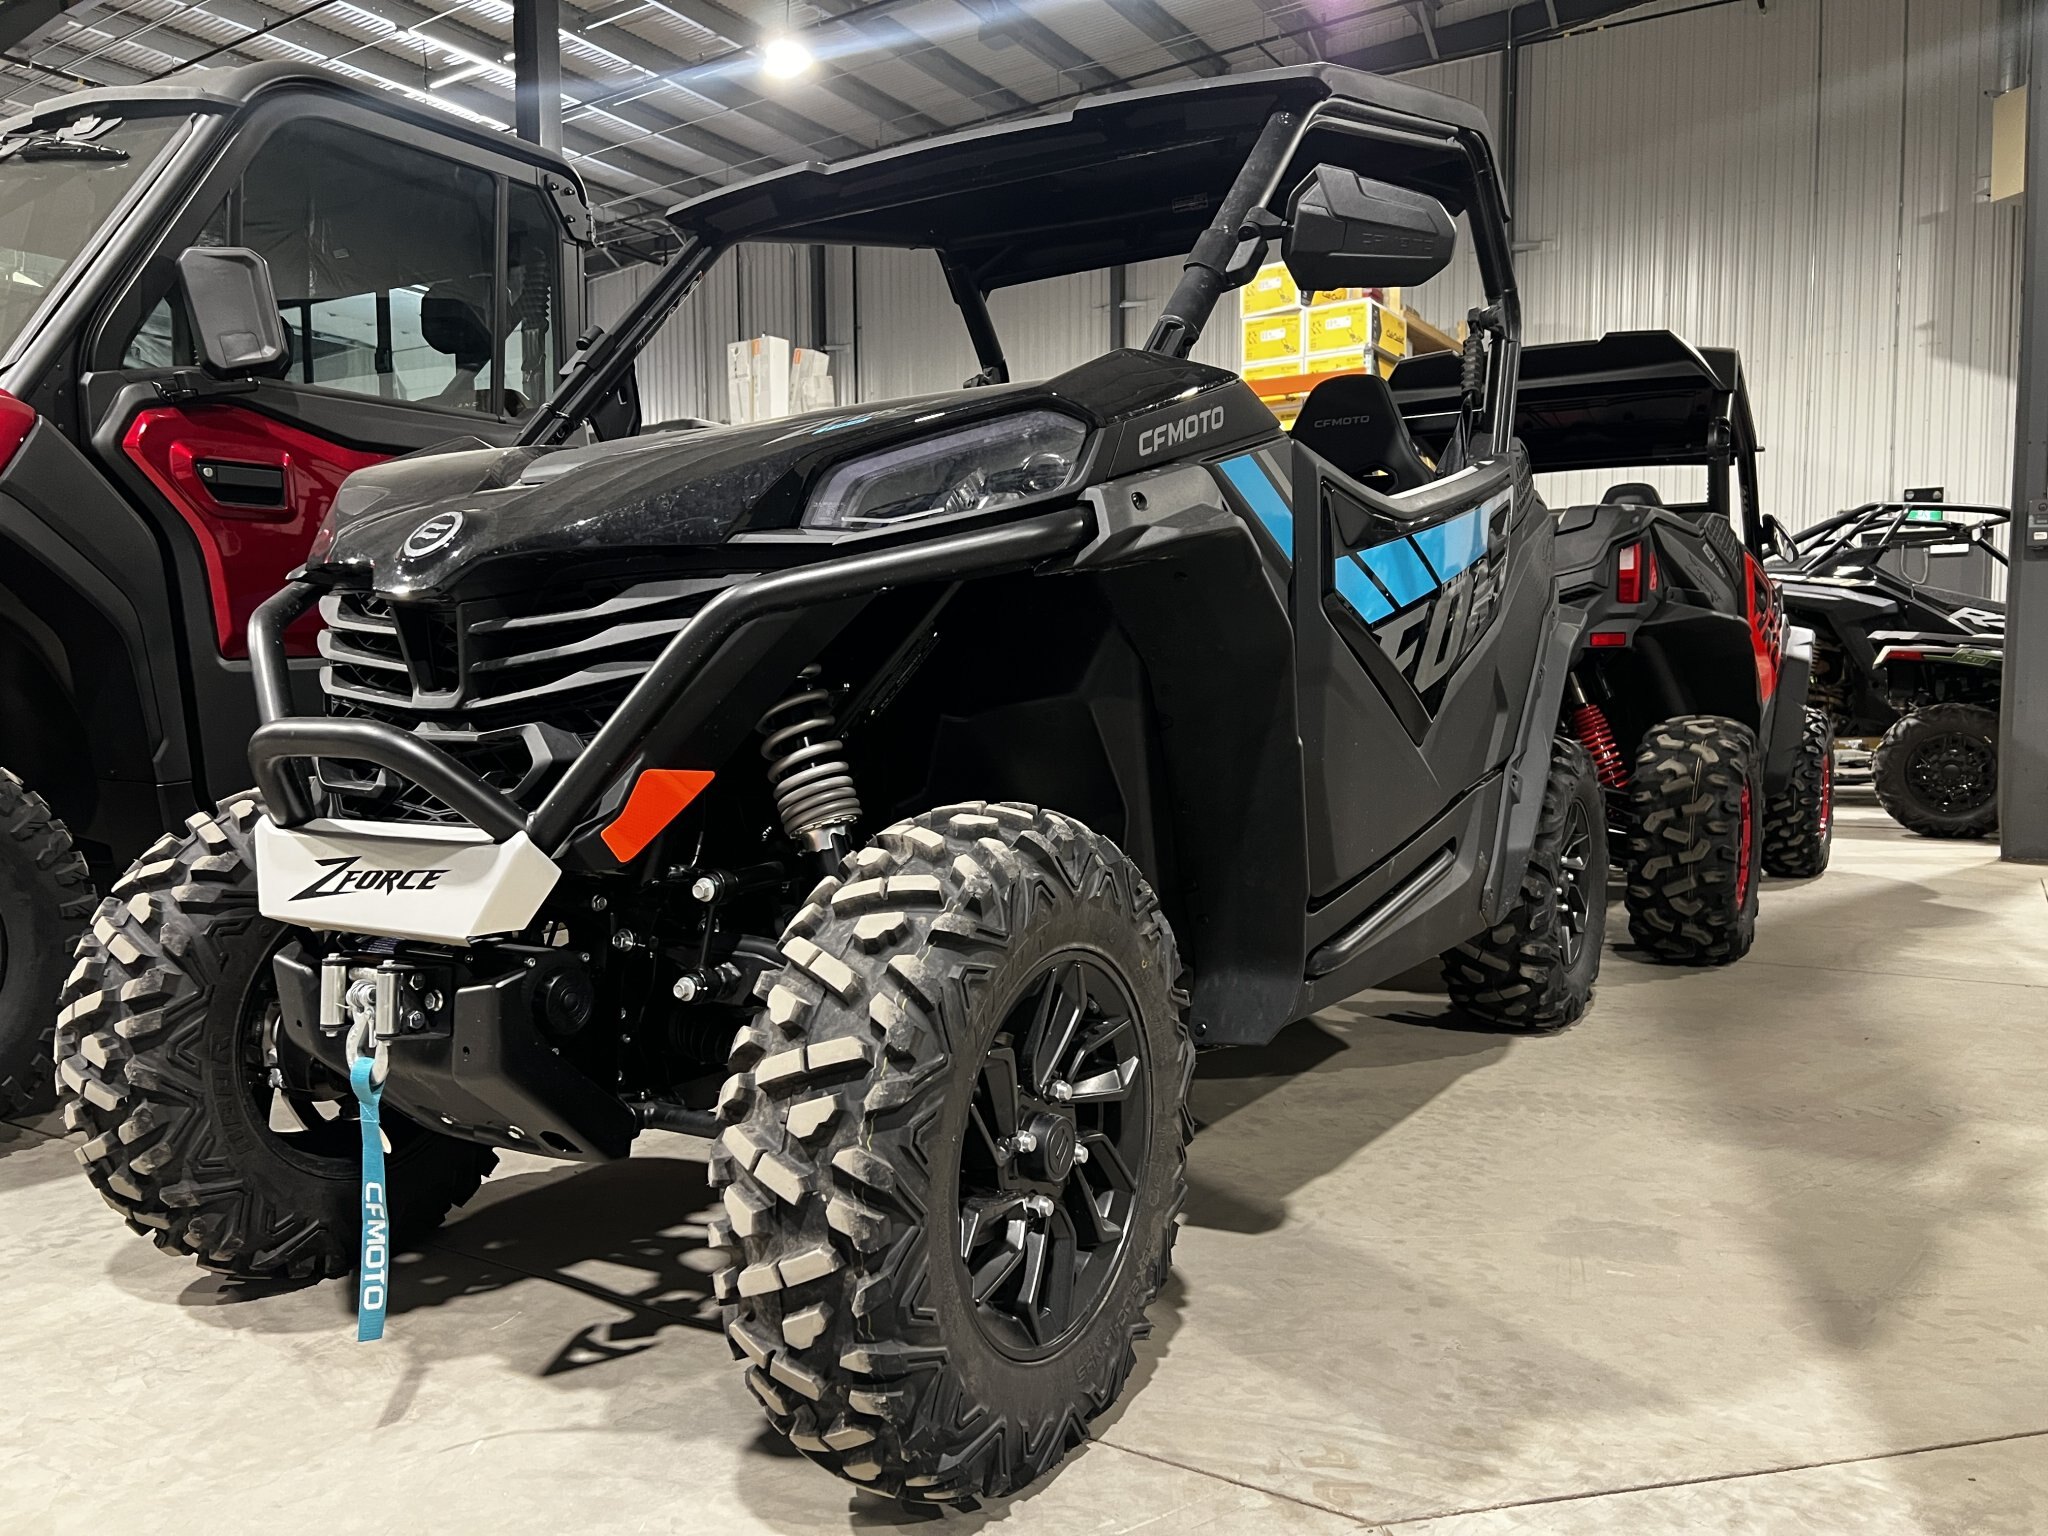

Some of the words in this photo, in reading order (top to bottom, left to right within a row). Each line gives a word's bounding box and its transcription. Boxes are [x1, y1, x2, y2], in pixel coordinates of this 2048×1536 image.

[1361, 232, 1435, 251] CFOTO
[1138, 405, 1225, 457] CFMOTO
[1313, 415, 1370, 429] CFMOTO
[287, 855, 453, 902] ZFORCE
[363, 1181, 387, 1311] CFMOTO
